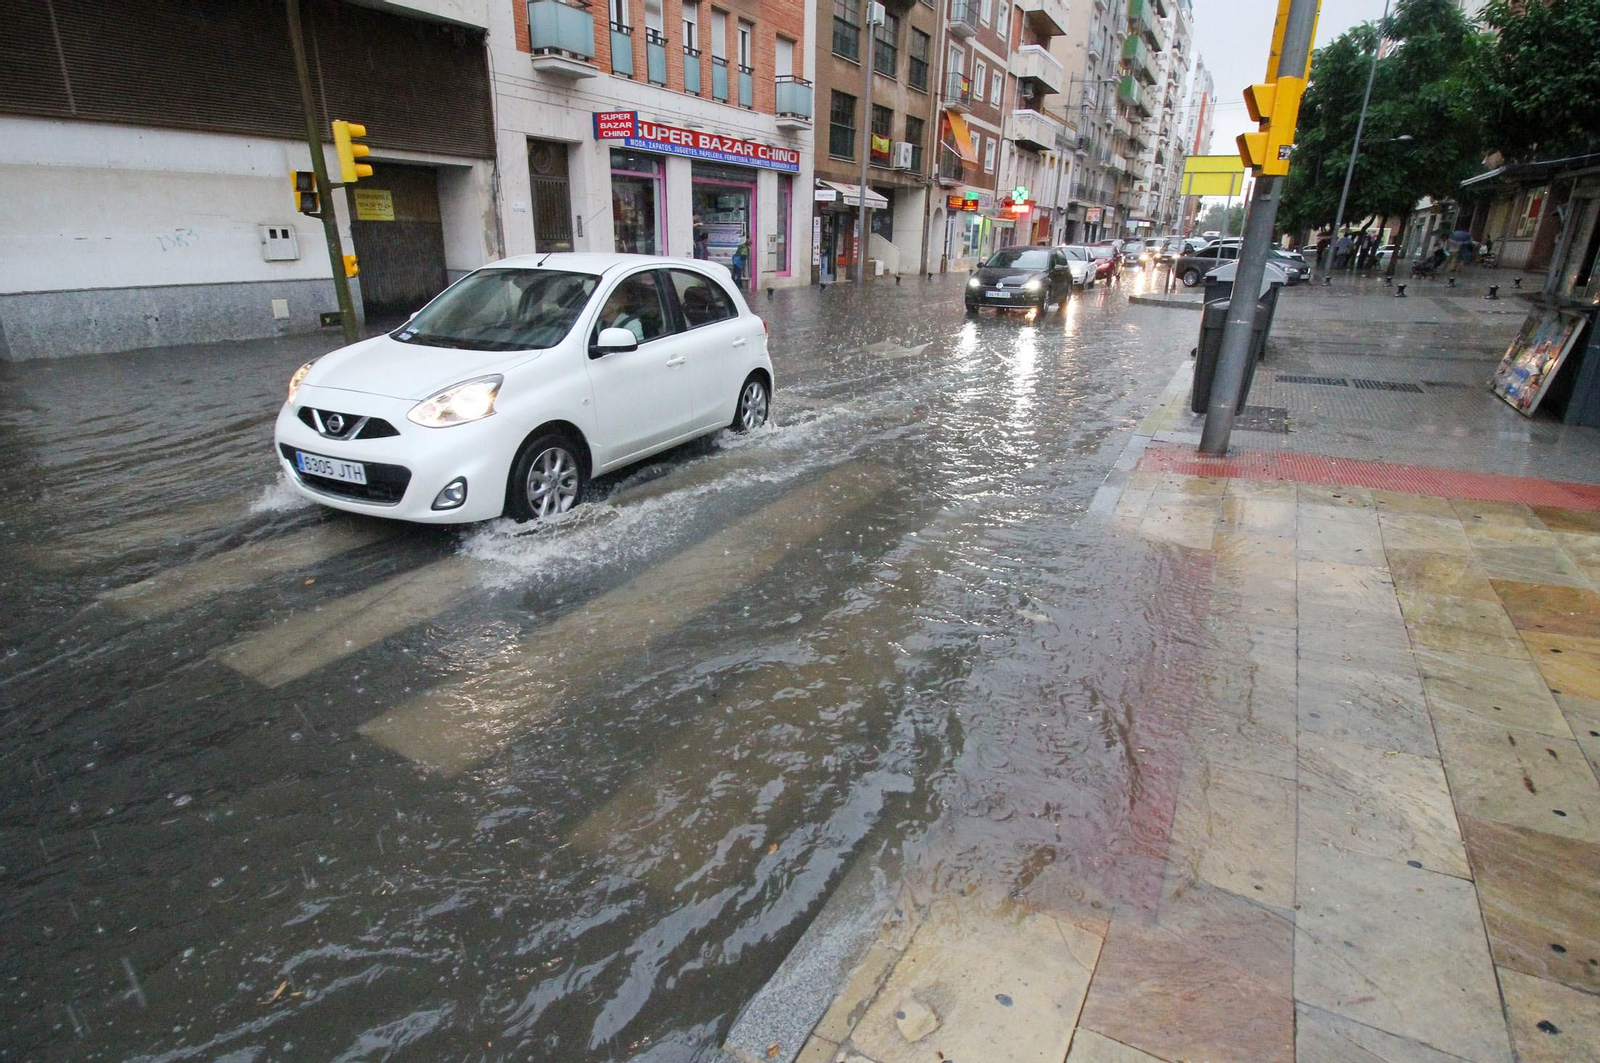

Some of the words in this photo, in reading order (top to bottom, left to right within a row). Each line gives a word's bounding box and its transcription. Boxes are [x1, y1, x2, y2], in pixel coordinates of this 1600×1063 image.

[601, 113, 631, 121] SUPER
[630, 138, 647, 149] MODA,
[648, 141, 674, 152] ZAPATOS,
[699, 135, 754, 156] BAZAR
[757, 146, 798, 164] CHINO
[304, 457, 334, 475] 6305
[339, 464, 363, 481] JTH
